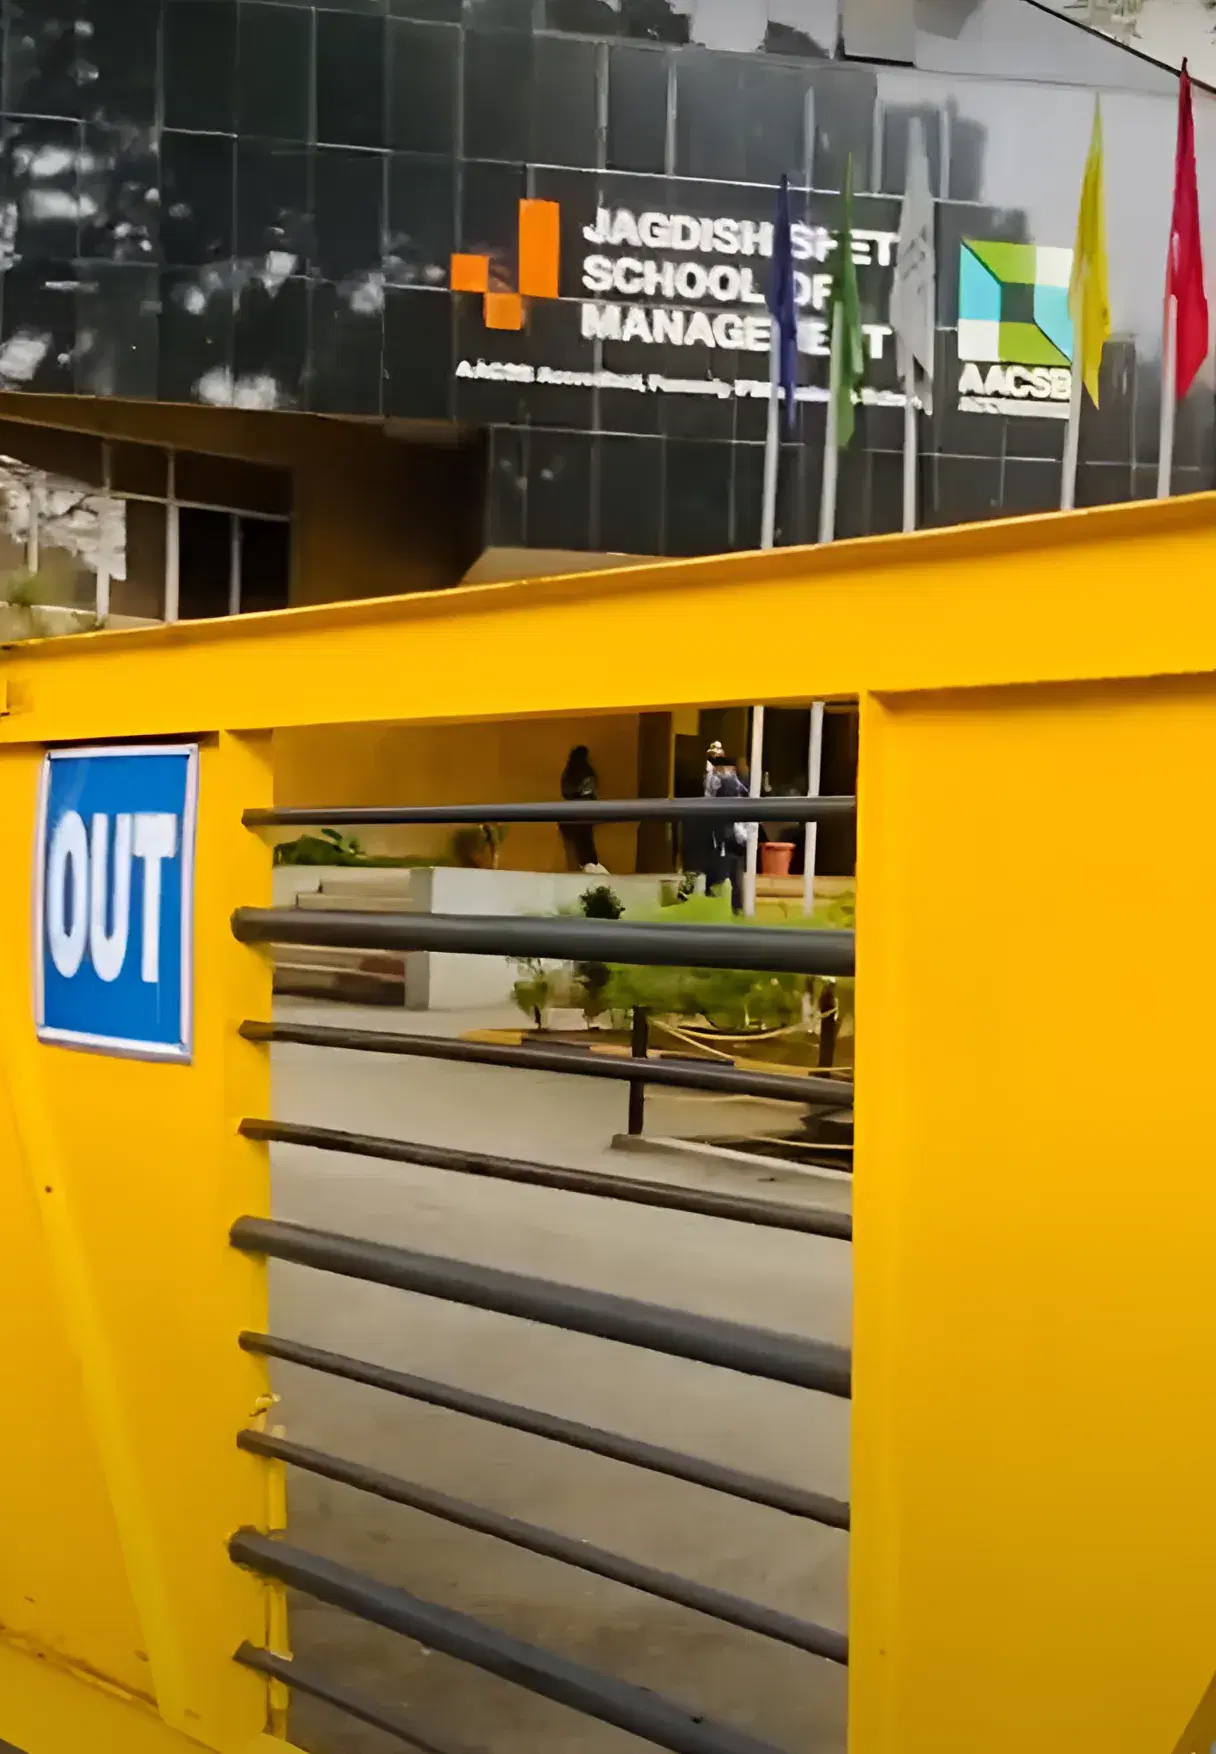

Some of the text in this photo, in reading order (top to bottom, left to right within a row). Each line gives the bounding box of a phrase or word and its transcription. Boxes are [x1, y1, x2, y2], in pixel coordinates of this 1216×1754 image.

[583, 206, 774, 256] JAGDISH
[582, 254, 766, 304] SCHOOL
[581, 303, 894, 359] MANAGEET
[958, 362, 1071, 400] AACSB
[47, 810, 178, 983] OUT
